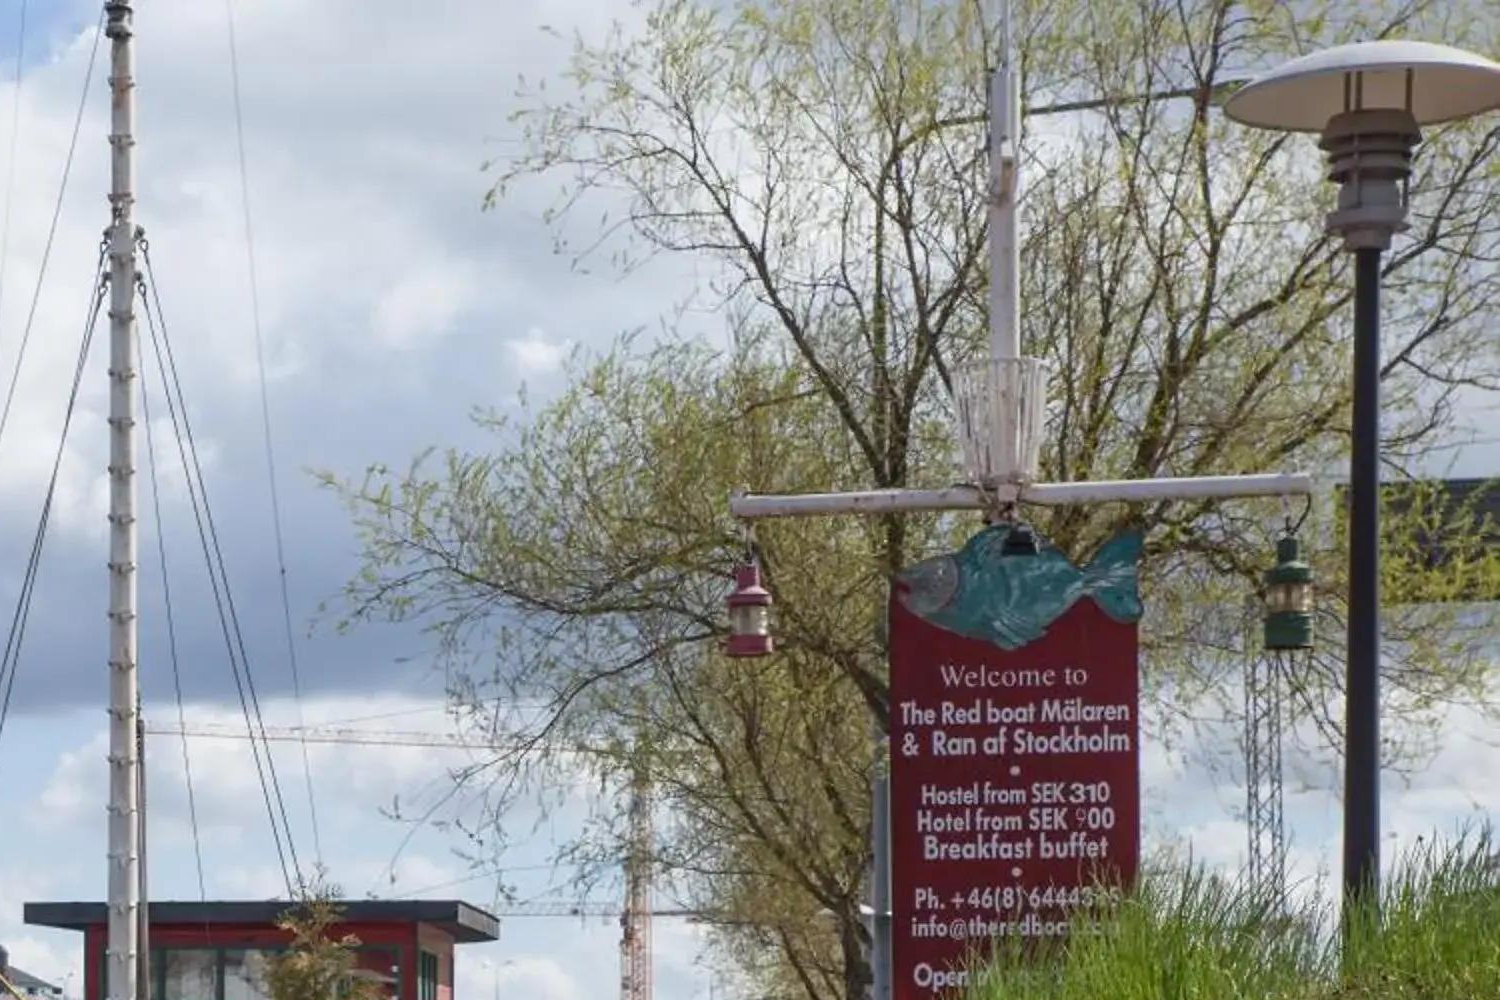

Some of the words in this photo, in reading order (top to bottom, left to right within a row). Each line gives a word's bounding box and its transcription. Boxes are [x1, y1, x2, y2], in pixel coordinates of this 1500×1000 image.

[940, 664, 1057, 688] Welcome
[1065, 666, 1088, 686] to
[900, 702, 936, 726] The
[941, 700, 981, 725] Red
[987, 699, 1035, 724] boat
[1041, 697, 1130, 722] Mälaren
[902, 732, 920, 757] &
[932, 731, 976, 756] Ran
[983, 725, 1008, 755] af
[1013, 725, 1130, 754] Stockholm
[921, 783, 979, 806] Hostel
[983, 782, 1027, 805] from
[1031, 783, 1065, 804] SEK
[1068, 782, 1111, 804] 310
[917, 809, 971, 833] Hotel
[975, 808, 1023, 832] from
[1029, 807, 1068, 831] SEK
[923, 834, 1034, 861] Breakfast
[1039, 831, 1109, 859] buffet
[915, 886, 946, 910] Ph.
[951, 886, 1022, 913] +46(8)
